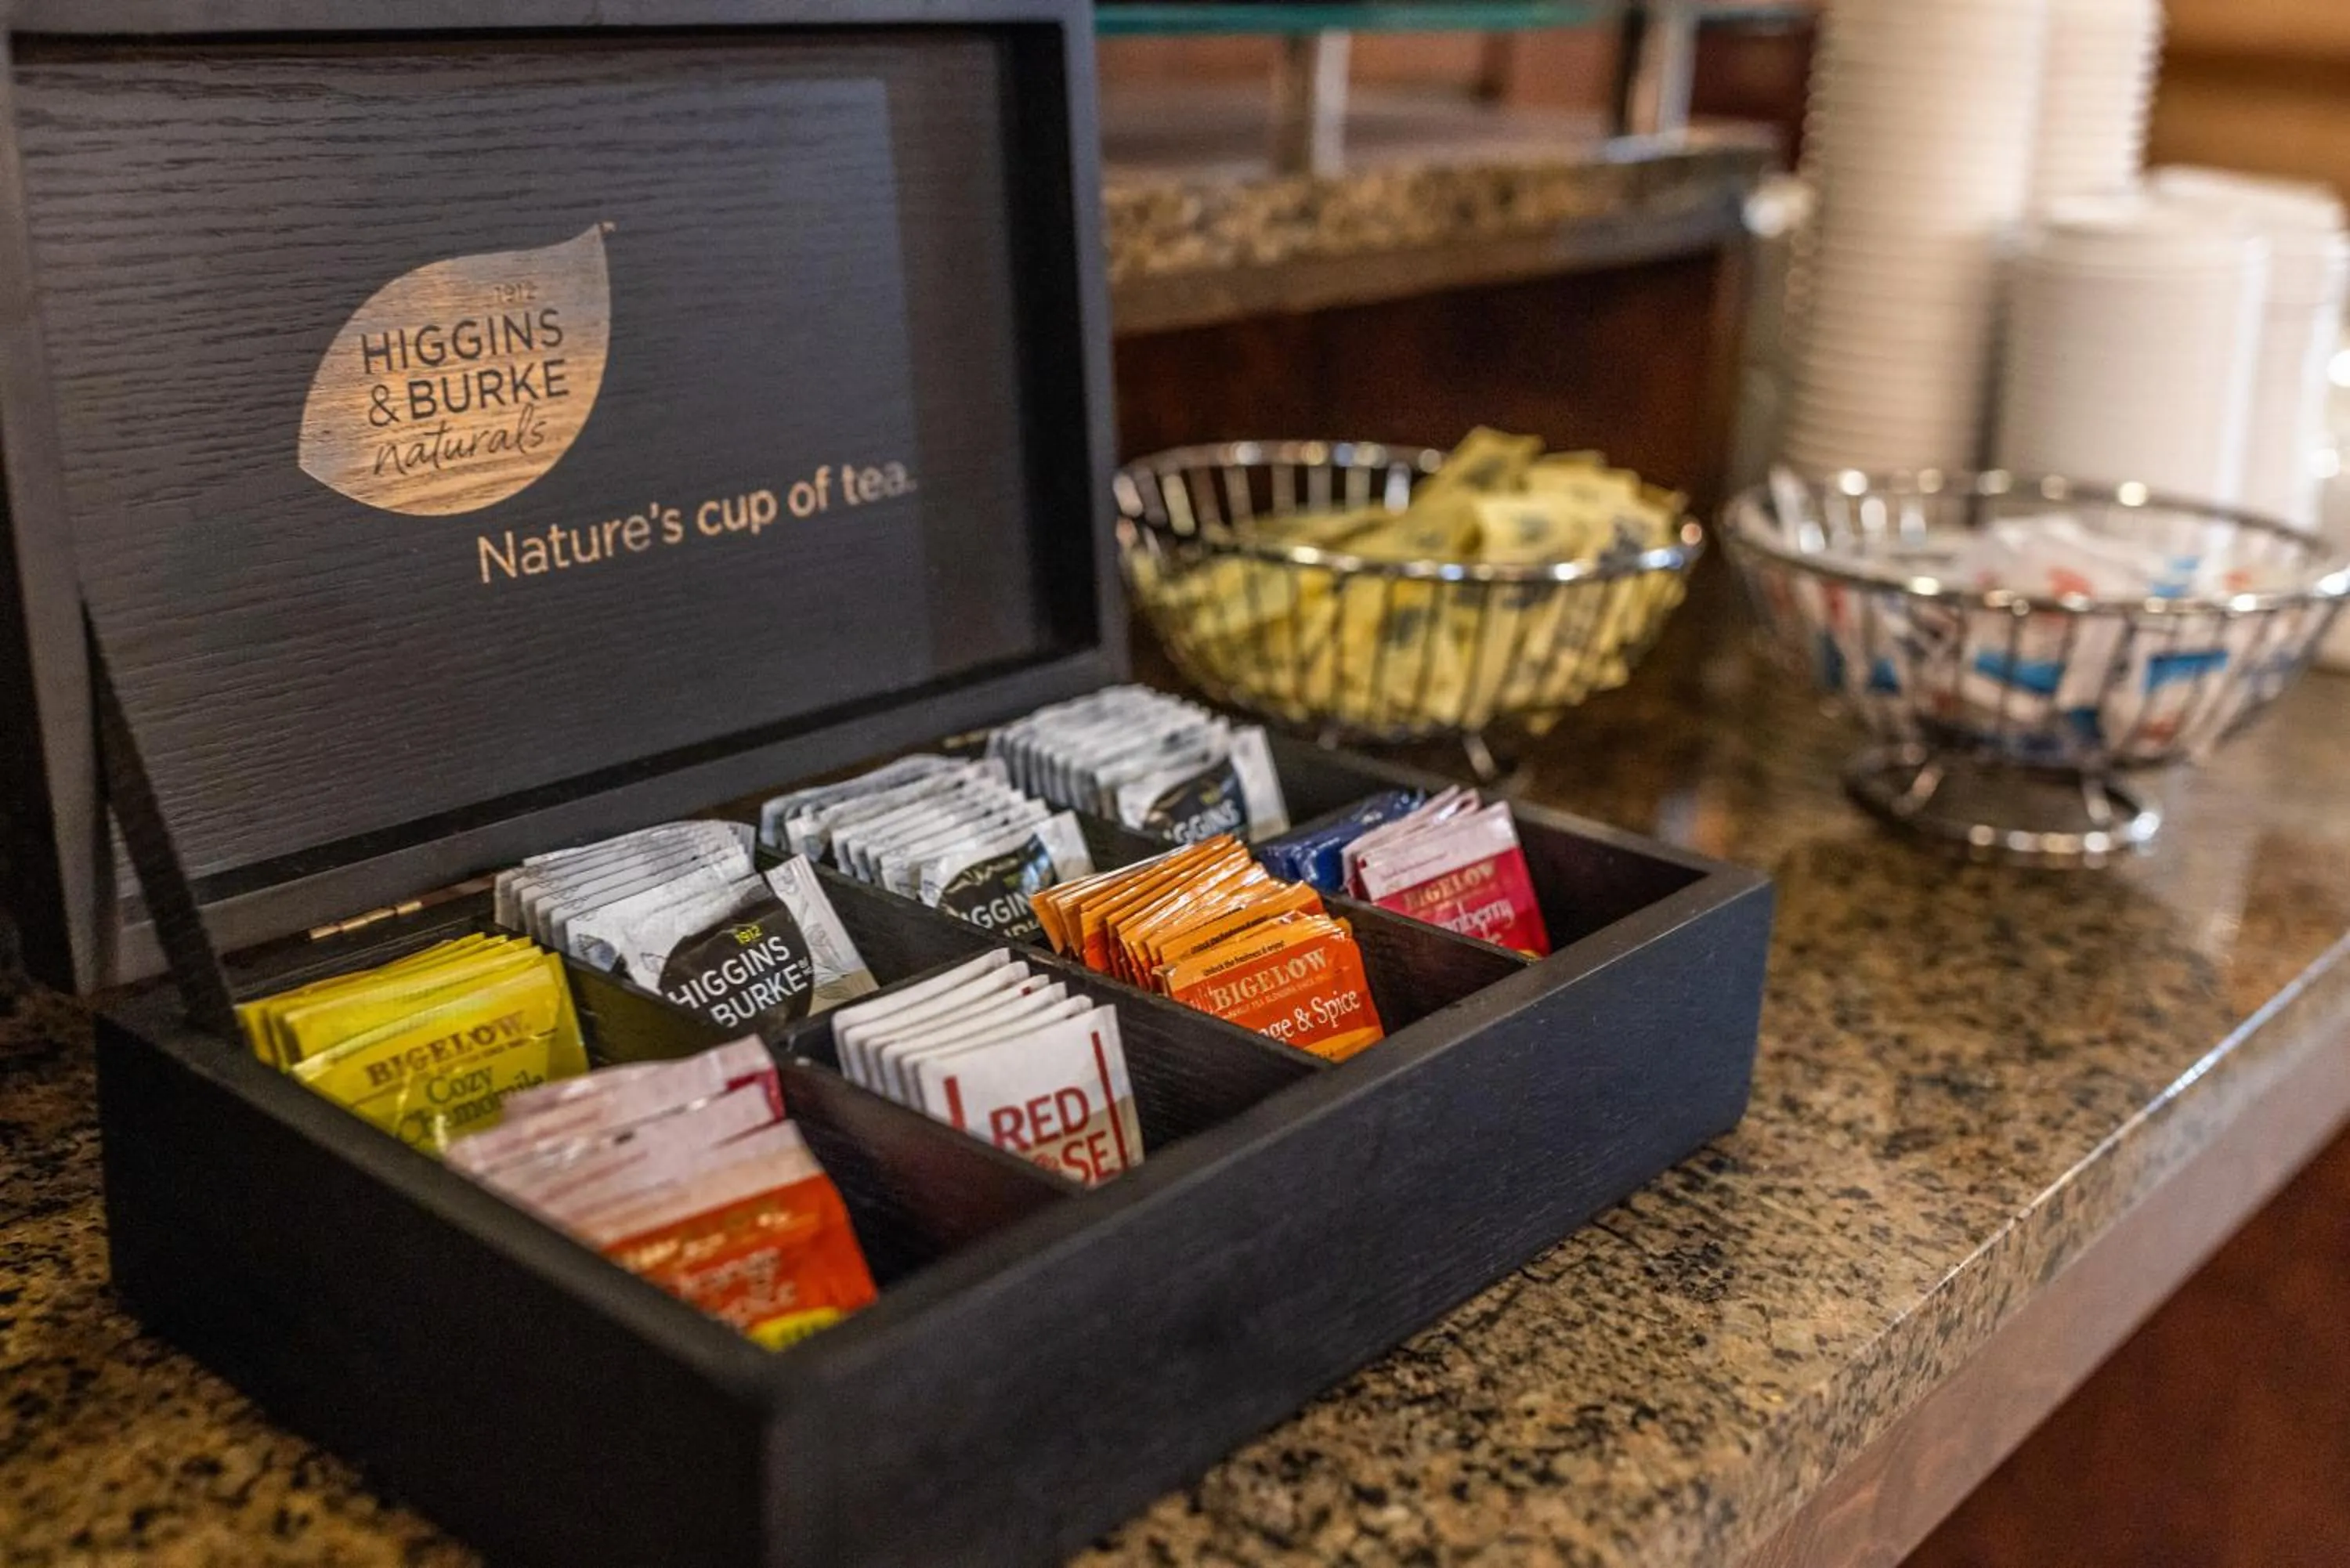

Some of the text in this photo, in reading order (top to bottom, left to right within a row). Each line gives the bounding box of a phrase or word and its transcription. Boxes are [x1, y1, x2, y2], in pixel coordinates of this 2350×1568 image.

[360, 309, 564, 375] HIGGINS
[367, 359, 571, 427] & BURKE
[372, 403, 548, 476] naturals
[476, 502, 684, 584] Nature's
[697, 489, 778, 539] cup
[787, 464, 832, 518] of
[667, 935, 791, 1010] HIGGINS
[710, 963, 808, 1028] BURKE
[1211, 945, 1328, 1010] BIGELOW
[1293, 1006, 1315, 1032] &
[1311, 990, 1361, 1029] Spice
[363, 1010, 526, 1089] BIGELOW
[424, 1064, 494, 1105] Cozy
[989, 1086, 1091, 1153] RED
